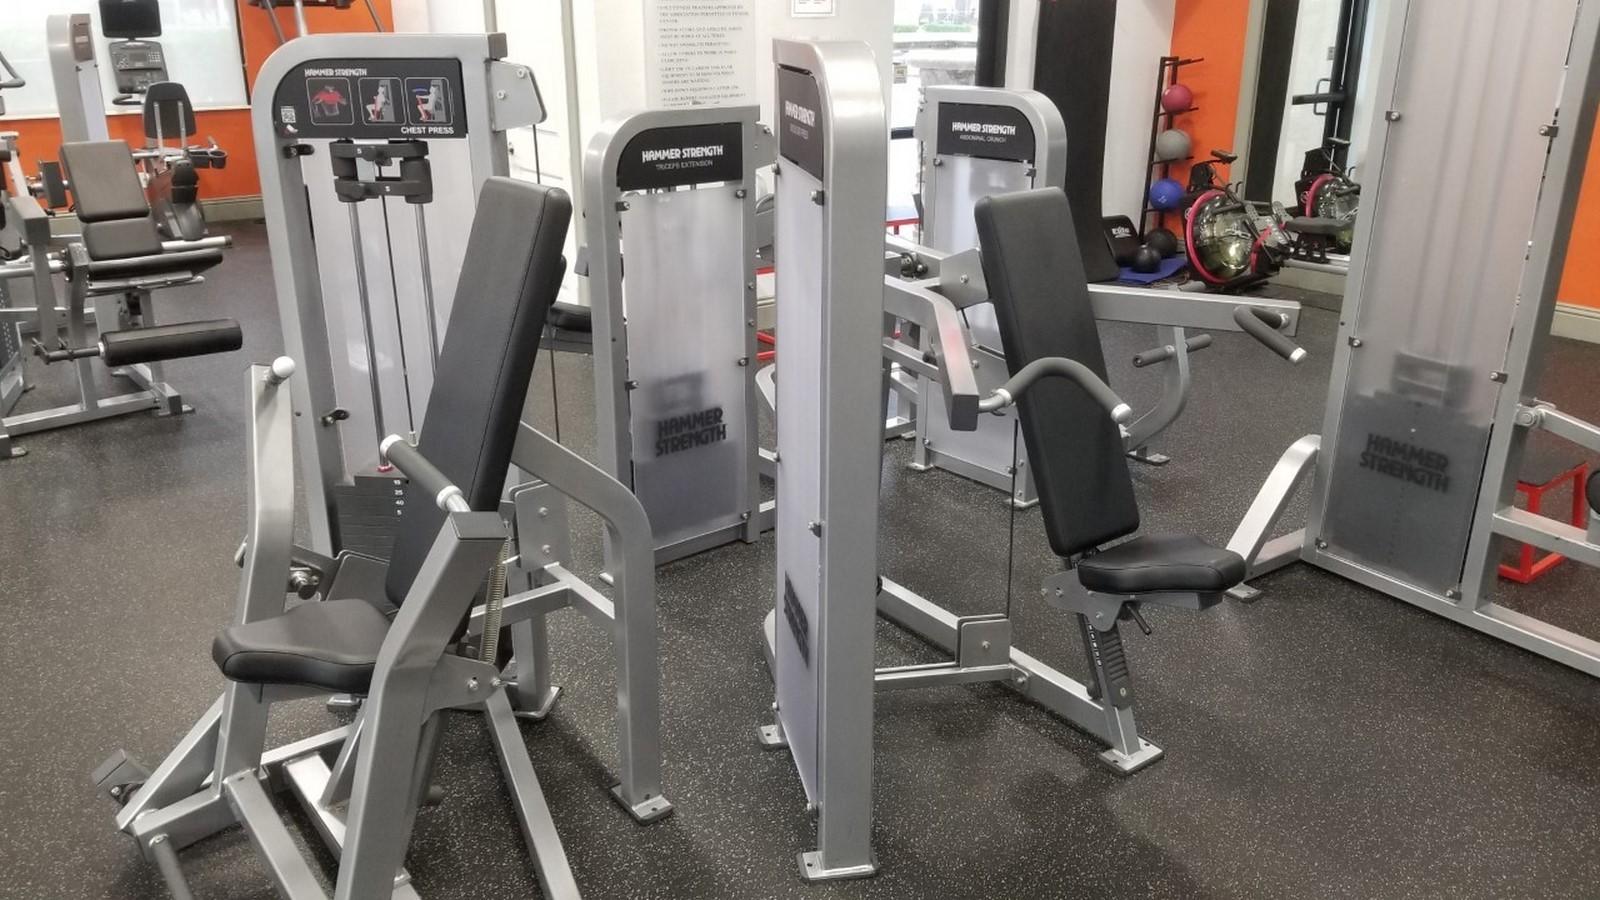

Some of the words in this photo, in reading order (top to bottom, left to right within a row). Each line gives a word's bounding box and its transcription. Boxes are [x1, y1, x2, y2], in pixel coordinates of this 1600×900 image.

[305, 68, 334, 77] HAMMER
[334, 68, 367, 77] STRENGTH
[400, 126, 426, 134] CHEST
[428, 126, 454, 134] PRESS
[952, 121, 981, 132] HAMMER
[982, 124, 1016, 135] STRENGTH
[642, 148, 681, 163] HAMMER
[682, 145, 723, 159] STRENGTH
[658, 407, 723, 439] HAMMER
[656, 423, 727, 458] STRENGTH
[1366, 433, 1449, 473] HAMMER
[1359, 451, 1449, 494] STRENGTH
